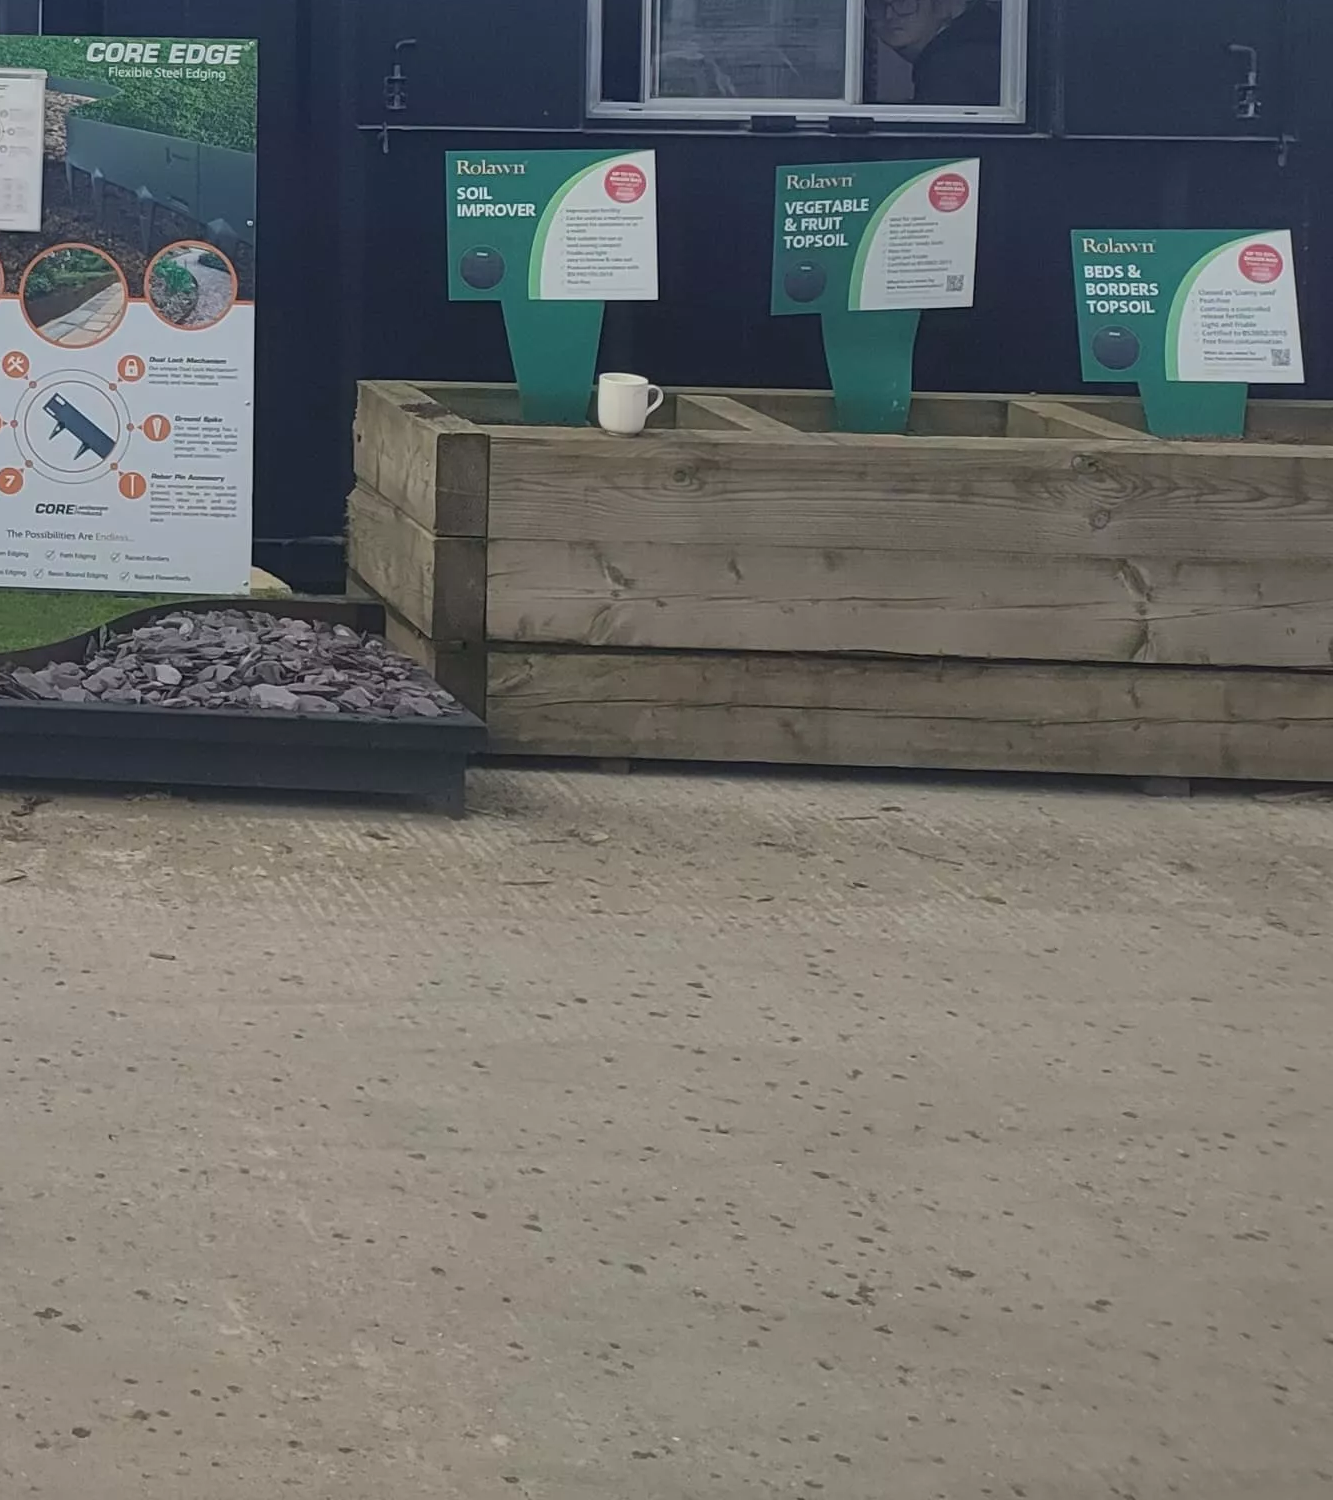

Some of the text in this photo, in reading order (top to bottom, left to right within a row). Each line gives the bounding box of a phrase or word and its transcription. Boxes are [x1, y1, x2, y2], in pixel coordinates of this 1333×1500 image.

[86, 42, 242, 65] CORE EDGE
[108, 67, 226, 82] Flexible Steel Edging
[456, 159, 526, 175] Rolawn
[786, 172, 853, 190] Rolawn
[456, 186, 493, 200] SOIL
[456, 203, 536, 217] IMPROVER
[785, 198, 870, 215] VEGETABLE
[784, 216, 843, 232] & FRUIT
[783, 233, 849, 250] TOPSOIL
[1081, 237, 1155, 254] Rolawn
[1084, 264, 1141, 279] BEDS &
[1085, 282, 1159, 297] BORDERS
[1086, 299, 1156, 314] TOPSOIL
[5, 475, 16, 488] 7
[35, 503, 76, 515] CORE
[7, 529, 23, 538] The
[25, 530, 76, 540] Possibilities
[78, 532, 94, 541] Are
[7, 550, 29, 558] Edging
[75, 553, 97, 561] Edging
[5, 569, 27, 578] Edging
[87, 571, 109, 580] Edging
